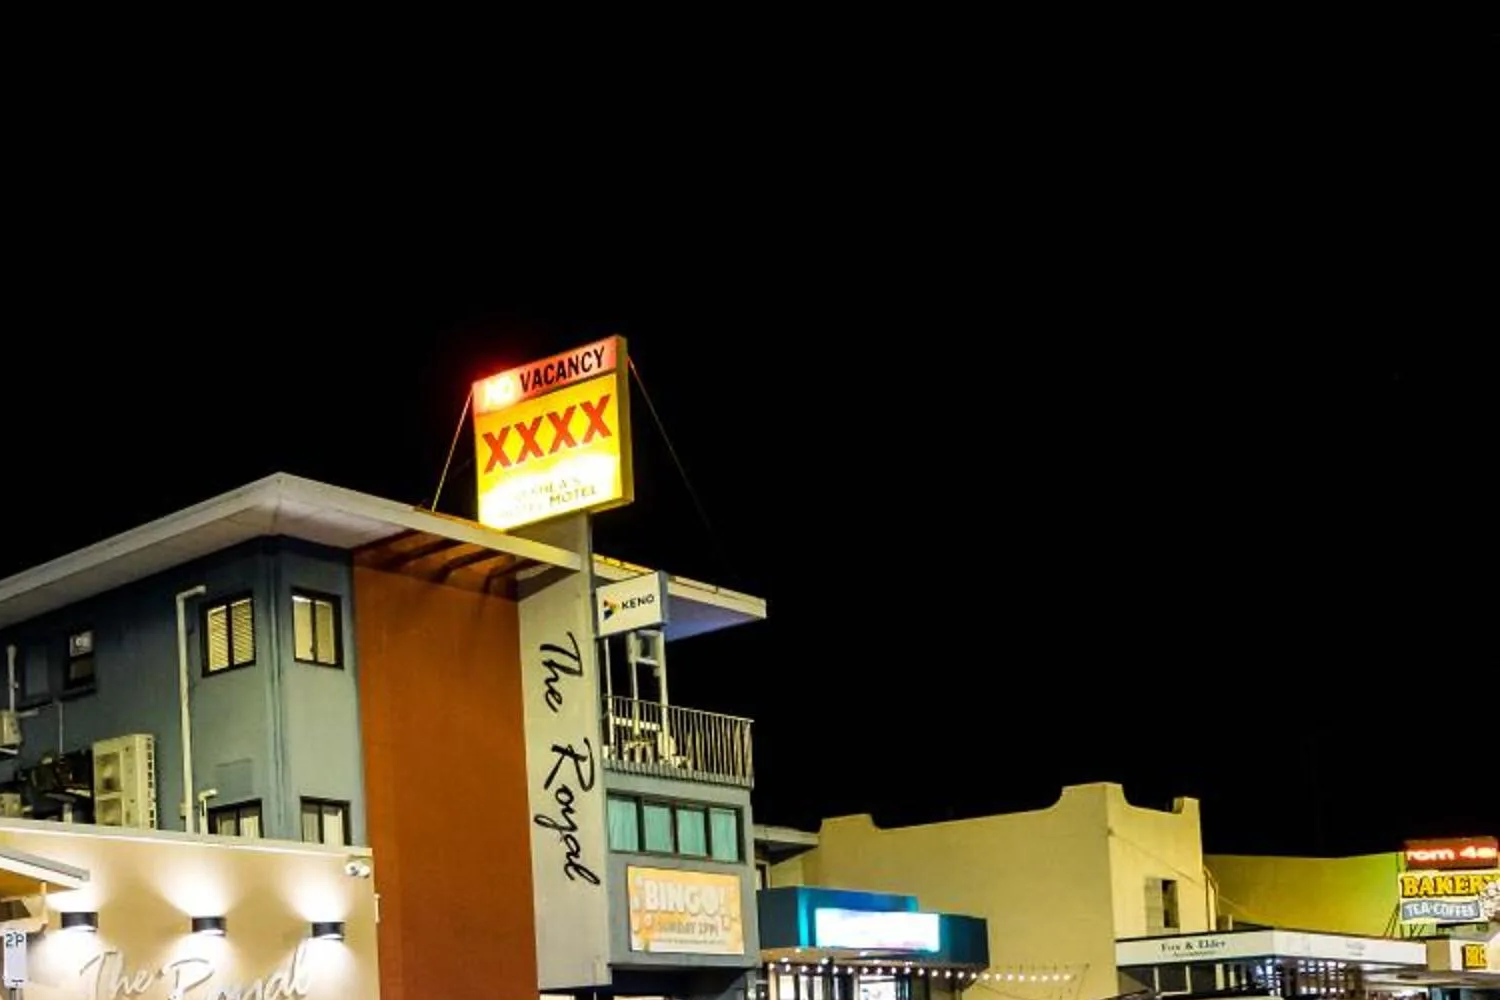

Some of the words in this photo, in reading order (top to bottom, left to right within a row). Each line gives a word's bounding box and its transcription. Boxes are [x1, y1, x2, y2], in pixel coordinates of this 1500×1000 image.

[519, 345, 606, 393] VACANCY
[482, 394, 613, 474] XXXX
[621, 592, 655, 610] KENO
[539, 631, 584, 713] The
[533, 737, 601, 886] Royal
[5, 933, 25, 948] 2P
